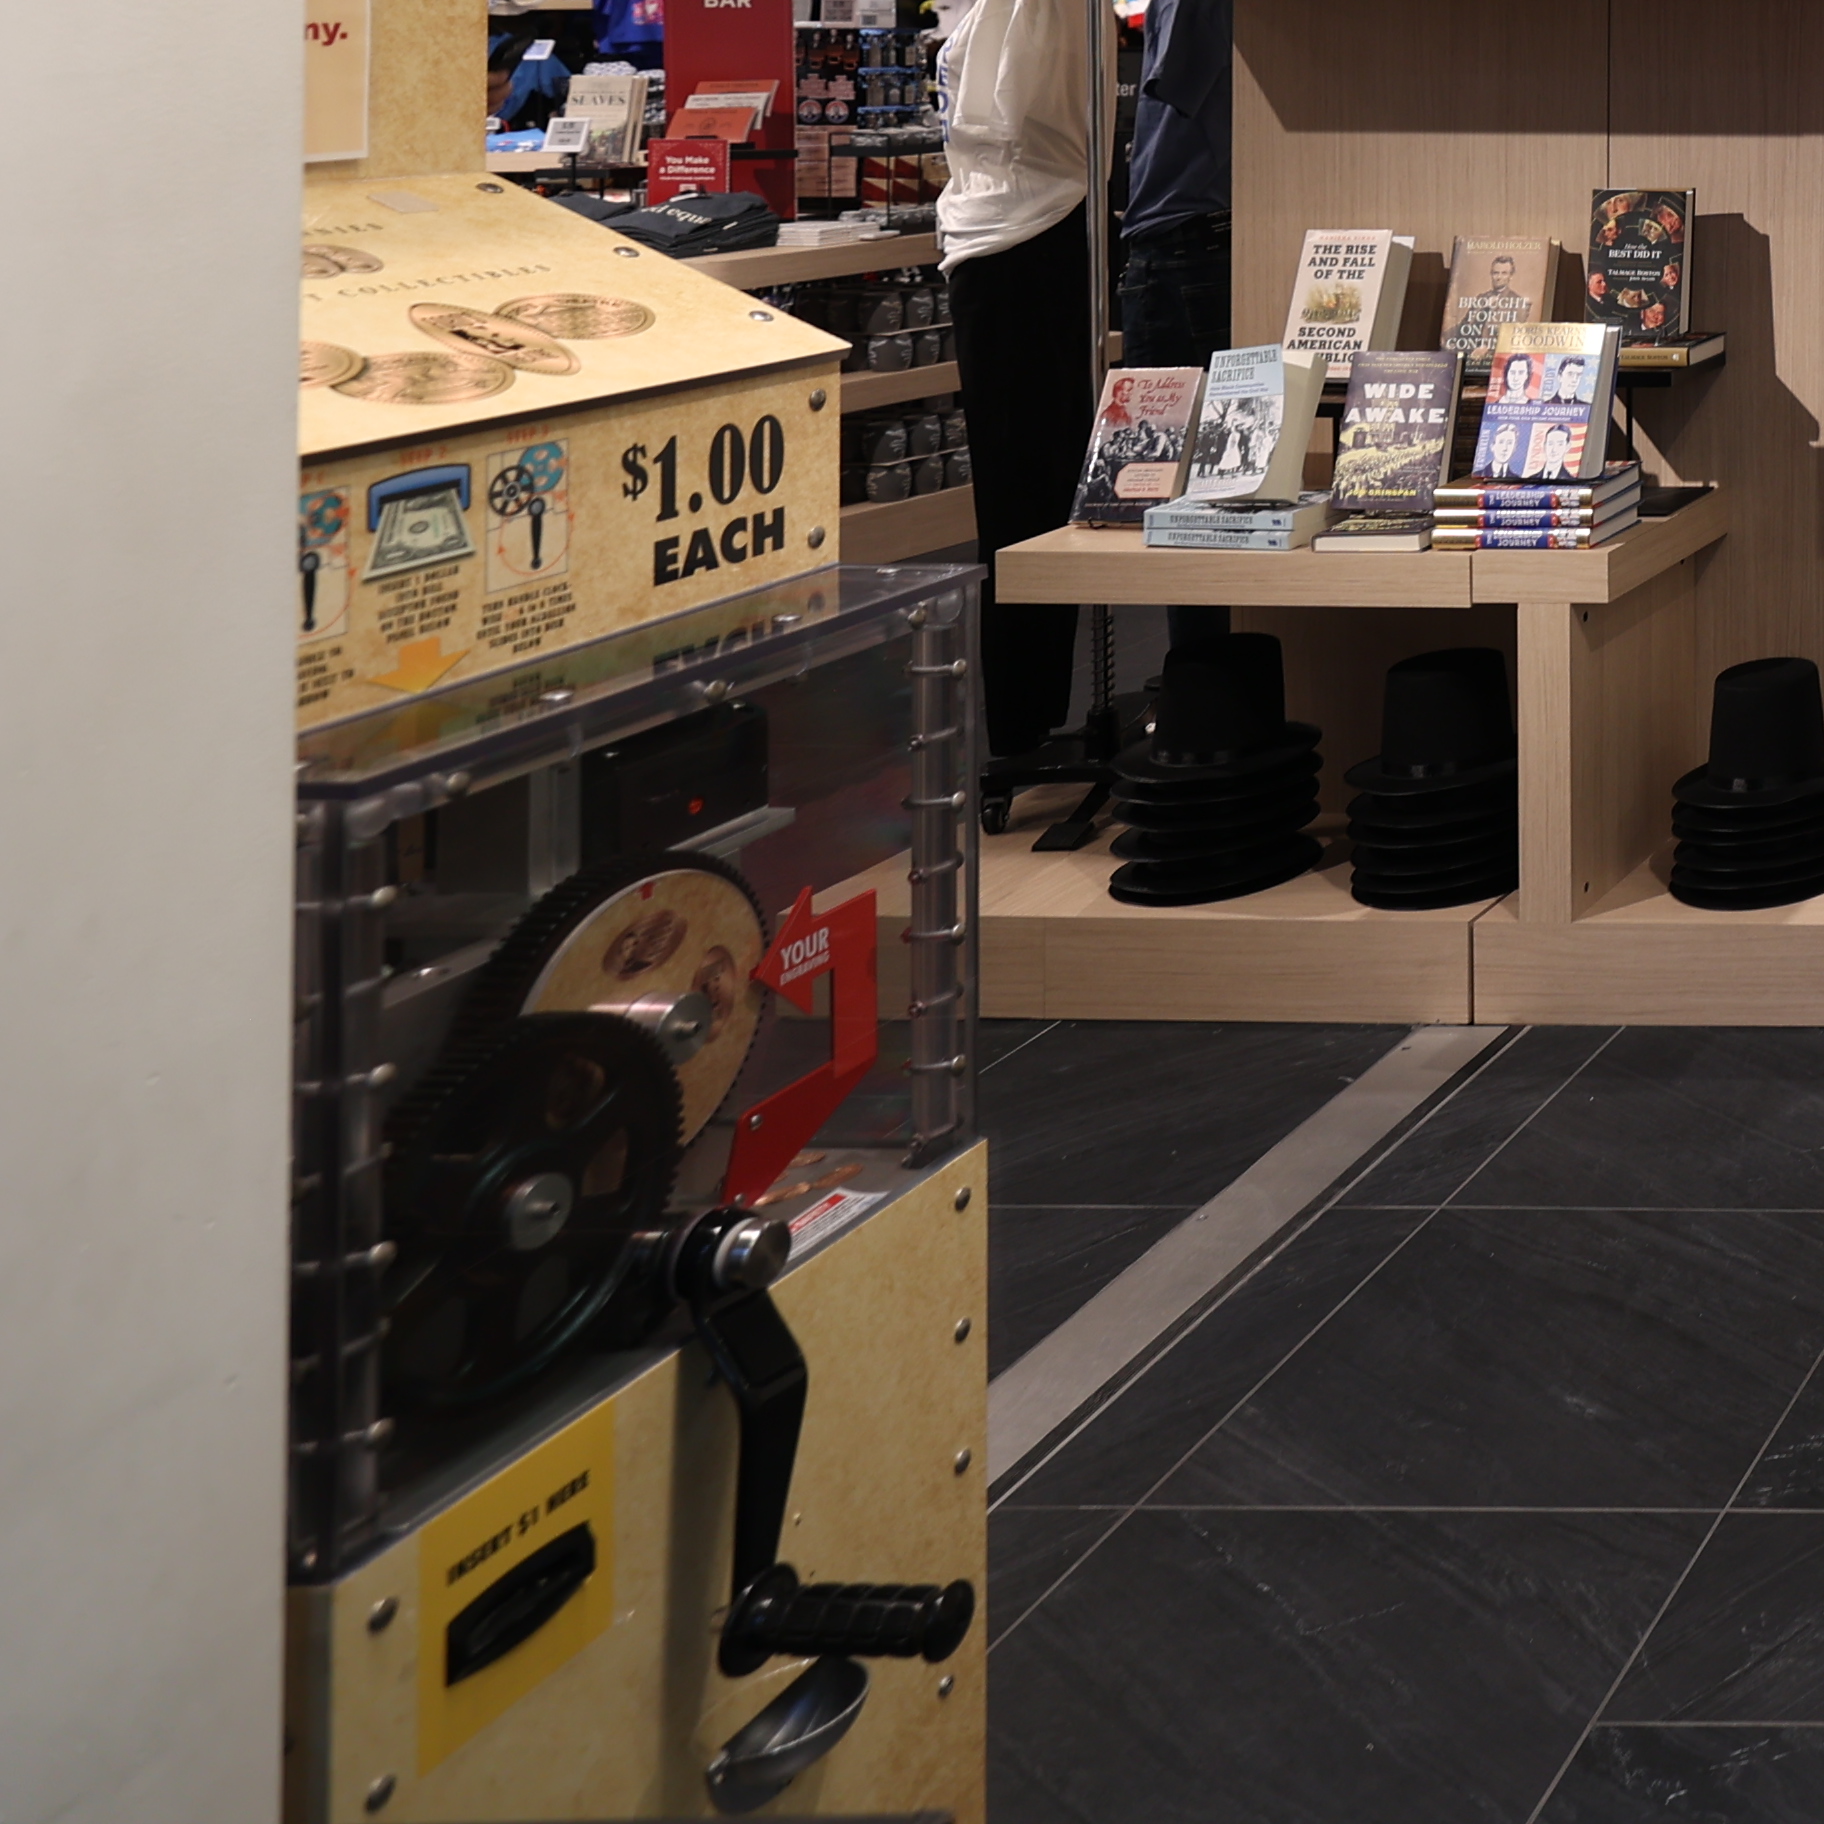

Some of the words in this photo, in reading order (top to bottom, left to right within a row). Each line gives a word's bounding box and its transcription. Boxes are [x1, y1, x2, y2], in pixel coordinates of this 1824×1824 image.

[571, 95, 626, 106] SLAVES
[665, 155, 682, 165] You
[684, 155, 710, 165] Make
[667, 165, 716, 175] Difference
[1313, 244, 1342, 255] THE
[1345, 244, 1377, 255] RISE
[1467, 241, 1506, 250] HAROLD
[1507, 241, 1541, 250] HOLZER
[1608, 250, 1632, 259] BEST
[1633, 250, 1650, 259] DID
[1651, 250, 1662, 259] IT
[1307, 257, 1339, 267] AND
[1341, 257, 1376, 267] FALL
[1314, 269, 1333, 279] OF
[1337, 269, 1366, 279] THE
[1458, 297, 1530, 309] BROUGHT
[1467, 310, 1517, 323] FORTH
[1298, 327, 1356, 338] SECOND
[1460, 324, 1483, 336] ON
[1511, 327, 1542, 335] DORIS
[1286, 340, 1363, 350] AMERICAN
[1510, 336, 1586, 347] GOODWIN
[1213, 349, 1278, 369] UNFORGETTABLE
[1210, 366, 1255, 384] SACRIFICE
[1152, 377, 1186, 391] Address
[1364, 383, 1435, 399] WIDE
[1162, 392, 1182, 407] My
[1136, 404, 1169, 419] Friend
[1345, 408, 1446, 423] AWAKE
[1487, 406, 1541, 415] LEADERSHIP
[1543, 407, 1586, 416] JOURNEY
[621, 414, 785, 523] $1.00
[1499, 499, 1540, 507] JOURNEY
[1500, 518, 1541, 526] JOURNEY
[653, 506, 785, 587] EACH
[1497, 538, 1538, 547] JOURNEY
[780, 927, 830, 970] YOUR
[446, 1524, 514, 1588] INSERT
[517, 1505, 540, 1537] $1
[546, 1468, 591, 1516] HERE
